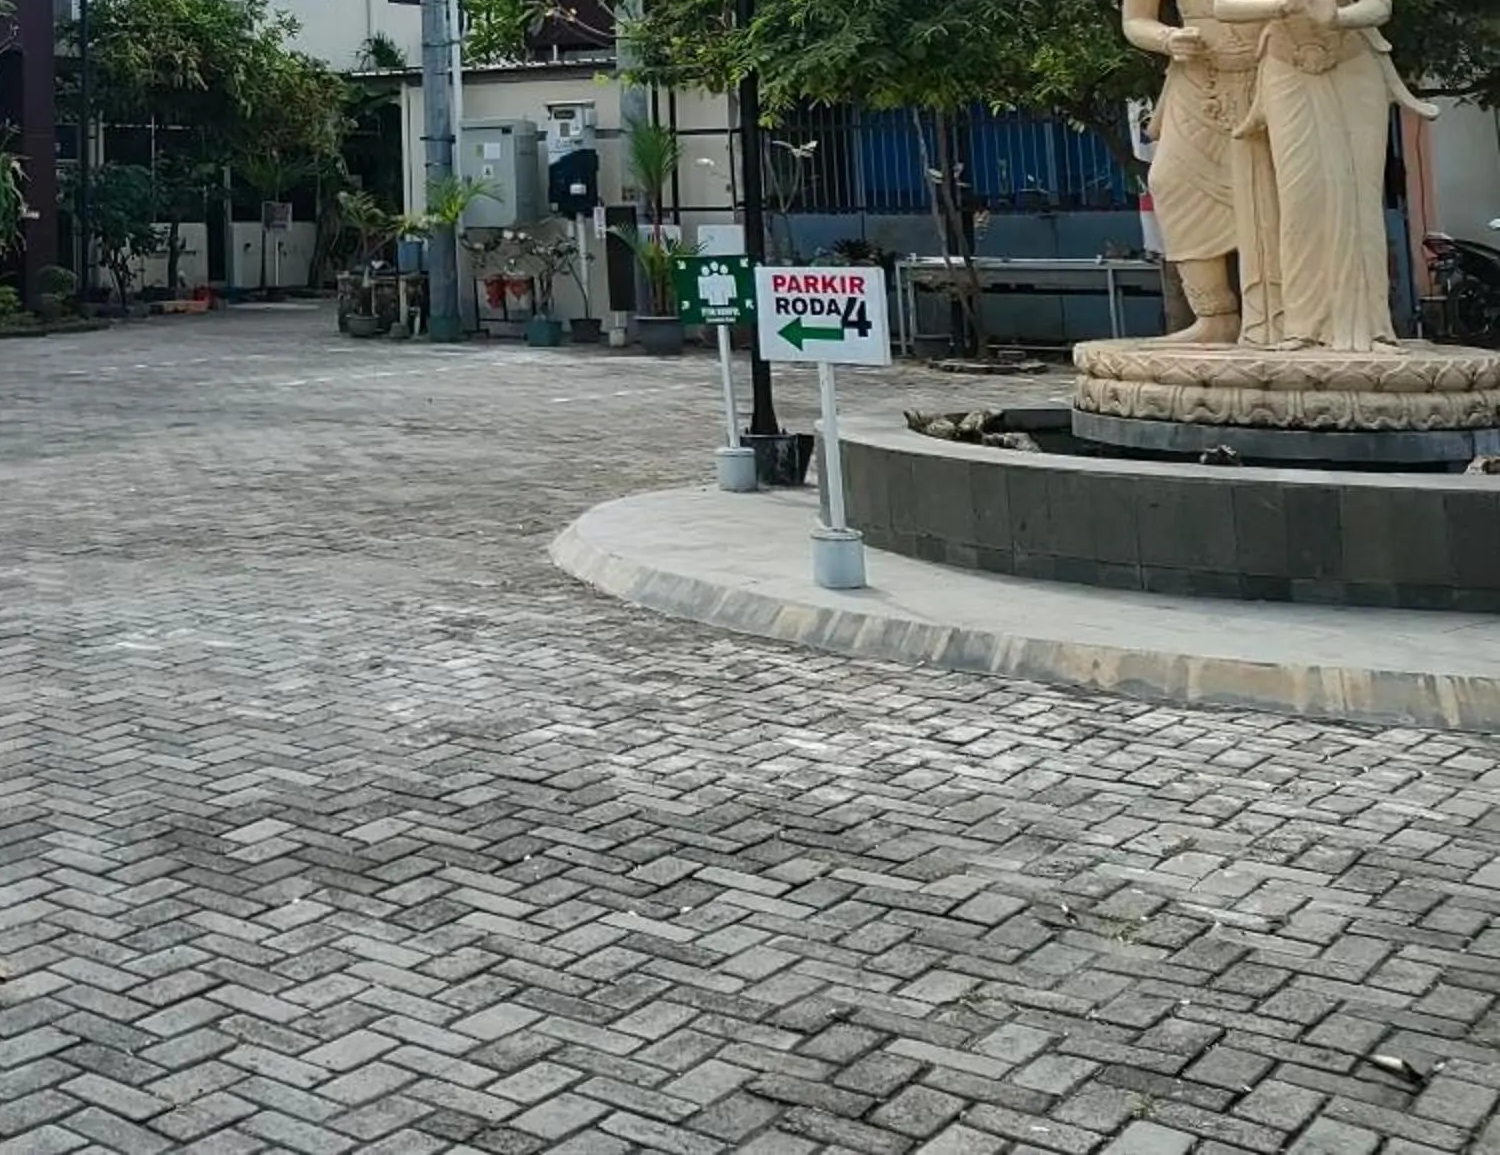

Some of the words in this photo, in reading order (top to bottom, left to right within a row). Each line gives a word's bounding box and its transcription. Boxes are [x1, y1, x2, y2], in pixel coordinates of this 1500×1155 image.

[772, 274, 865, 294] PARKIR
[775, 297, 841, 316] RODA
[841, 297, 872, 337] 4
